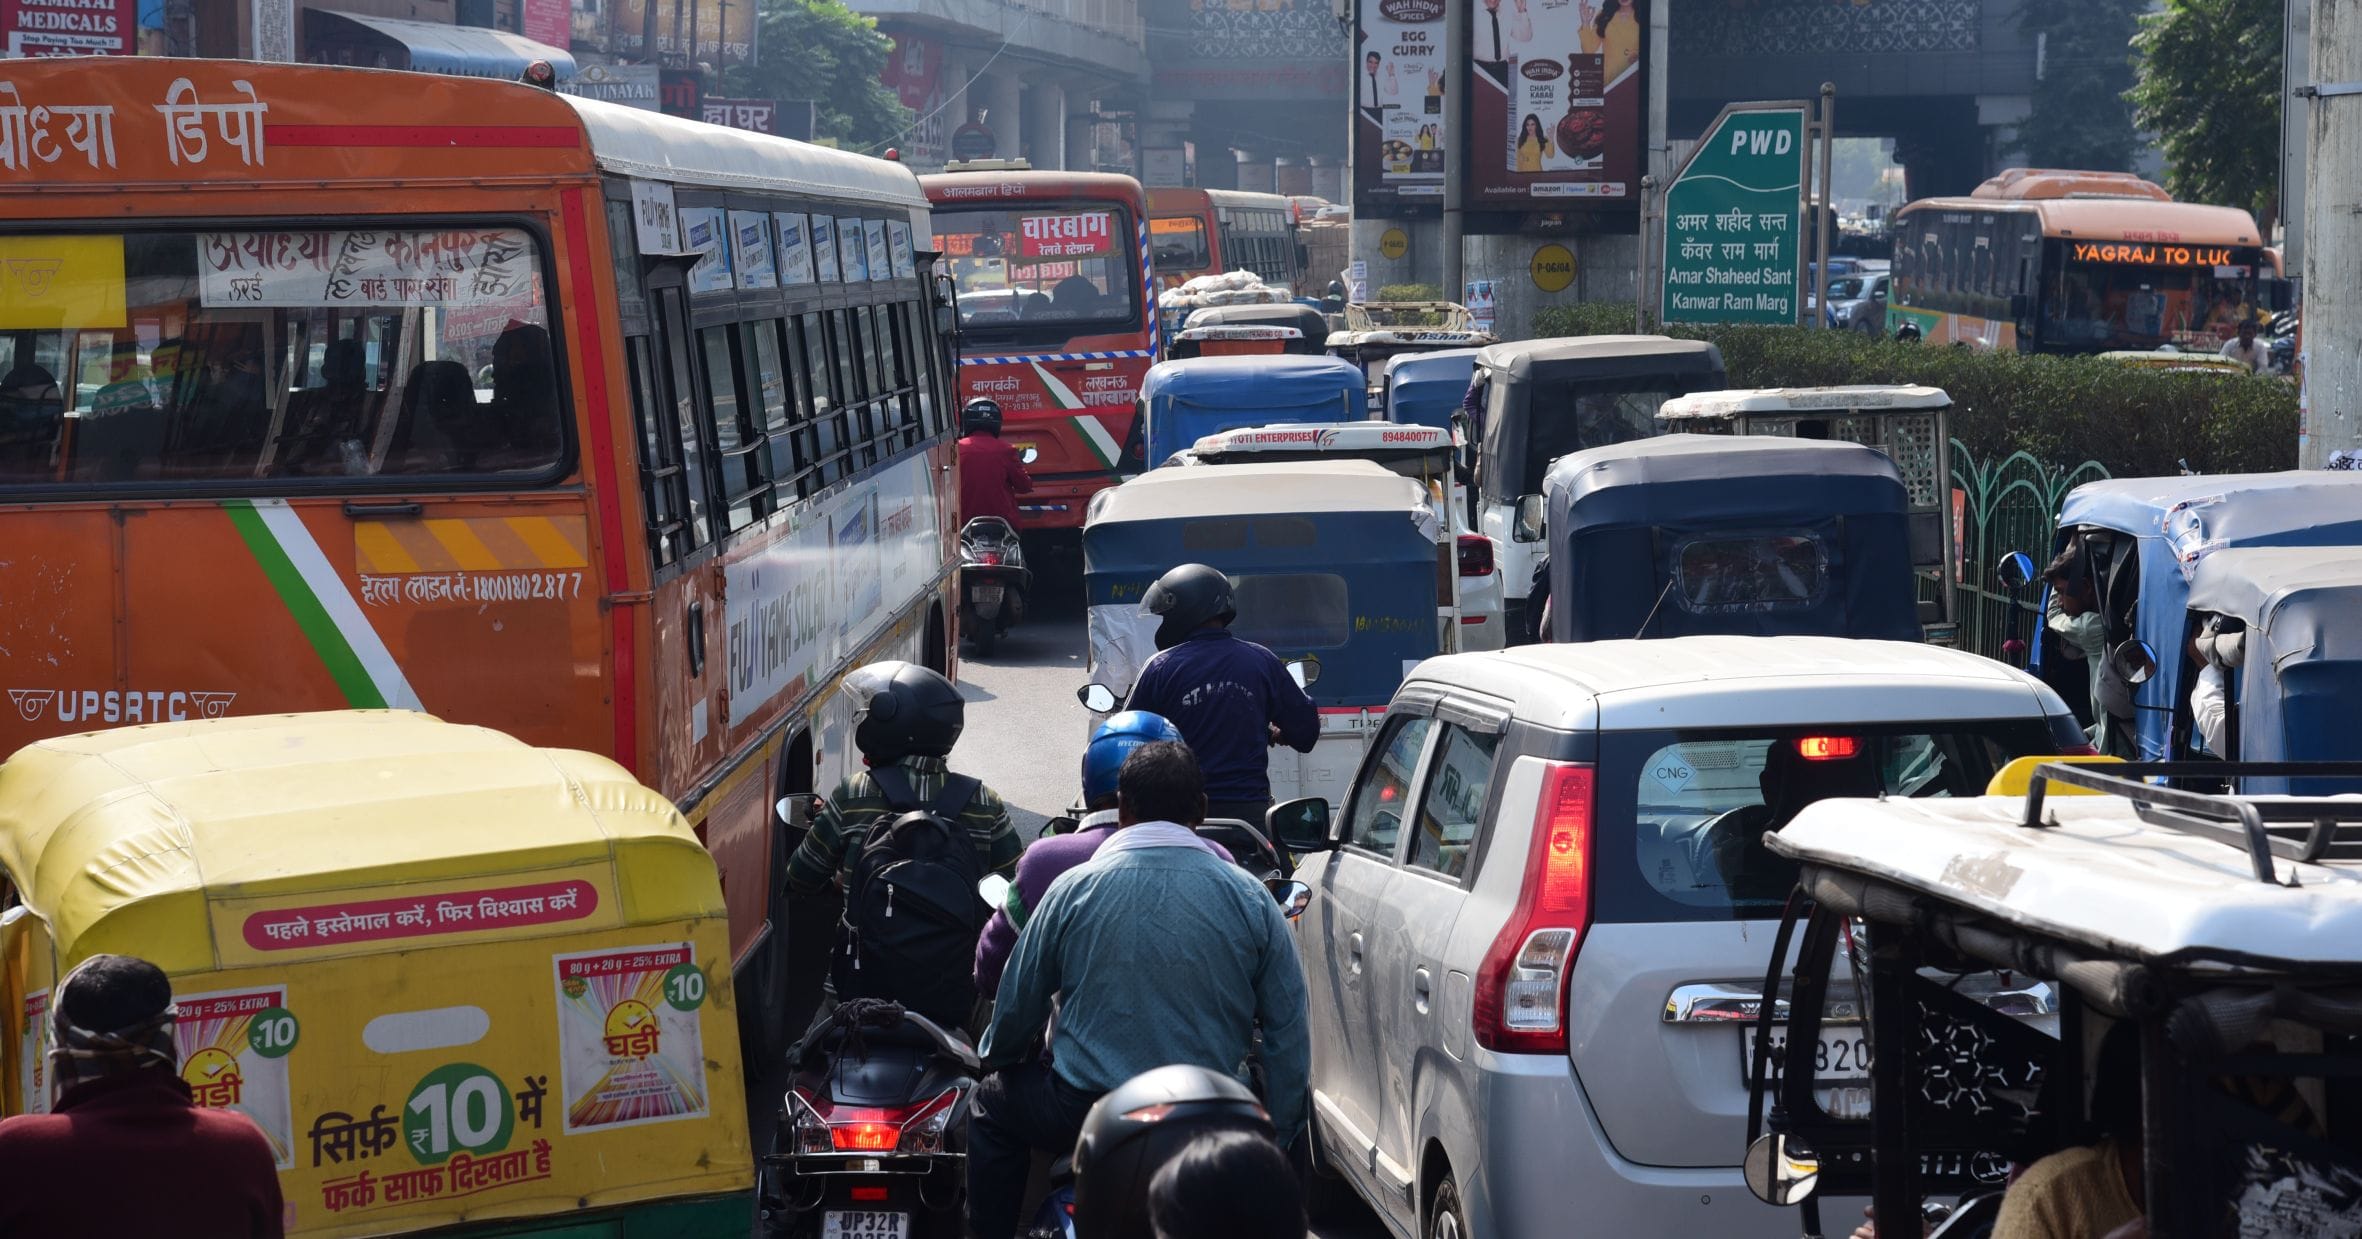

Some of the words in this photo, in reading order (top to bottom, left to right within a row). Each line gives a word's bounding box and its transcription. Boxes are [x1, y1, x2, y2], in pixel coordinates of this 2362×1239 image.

[18, 11, 117, 32] MEDICALS
[22, 34, 40, 43] Stop
[42, 36, 67, 45] Paying
[70, 37, 83, 45] Too
[1401, 31, 1426, 42] EGG
[1392, 45, 1435, 56] CURRY
[592, 83, 655, 99] VINAYAK
[152, 78, 268, 167] डिपो
[1731, 129, 1792, 155] PWD
[1000, 181, 1026, 197] डिपो
[1484, 186, 1516, 194] Available
[1021, 213, 1110, 240] चारबाग
[1675, 213, 1709, 231] अमर
[1715, 207, 1752, 232] शहीद
[1758, 213, 1788, 231] सन्त
[1039, 242, 1062, 255] रेलवे
[1065, 243, 1095, 255] स्टेशन
[1721, 242, 1745, 260] राम
[1753, 236, 1780, 261] मार्ग
[2074, 243, 2155, 264] YAGRAJ
[2164, 247, 2190, 265] TO
[1668, 267, 1703, 284] Amar
[1705, 267, 1761, 285] Shaheed
[1763, 267, 1792, 285] Sant
[1672, 292, 1721, 310] Kanwar
[1723, 293, 1753, 310] Ram
[1756, 295, 1788, 315] Marg
[972, 375, 1022, 393] बाराबंकी
[1086, 375, 1129, 391] लखनऊ
[1255, 430, 1313, 444] ENTERPRISES
[1381, 430, 1439, 443] 8948400777
[57, 690, 187, 723] UPSRTC
[1656, 769, 1689, 781] CNG
[264, 915, 310, 941] पहले
[314, 911, 390, 937] इस्तेमाल
[395, 904, 432, 927] करें,
[436, 901, 474, 923] फिर
[477, 896, 544, 919] विश्वास
[548, 887, 579, 911] करें
[570, 962, 583, 974] 80
[601, 959, 614, 971] 20
[632, 956, 653, 968] 25%
[654, 953, 681, 965] EXTRA
[178, 1005, 193, 1018] 20
[214, 1000, 238, 1014] 25%
[239, 996, 271, 1010] EXTRA
[604, 1023, 660, 1061] घड़ी
[308, 1104, 400, 1168] सिर्फ़
[516, 1075, 548, 1129] में
[448, 1150, 529, 1193] दिखता
[532, 1138, 552, 1174] है
